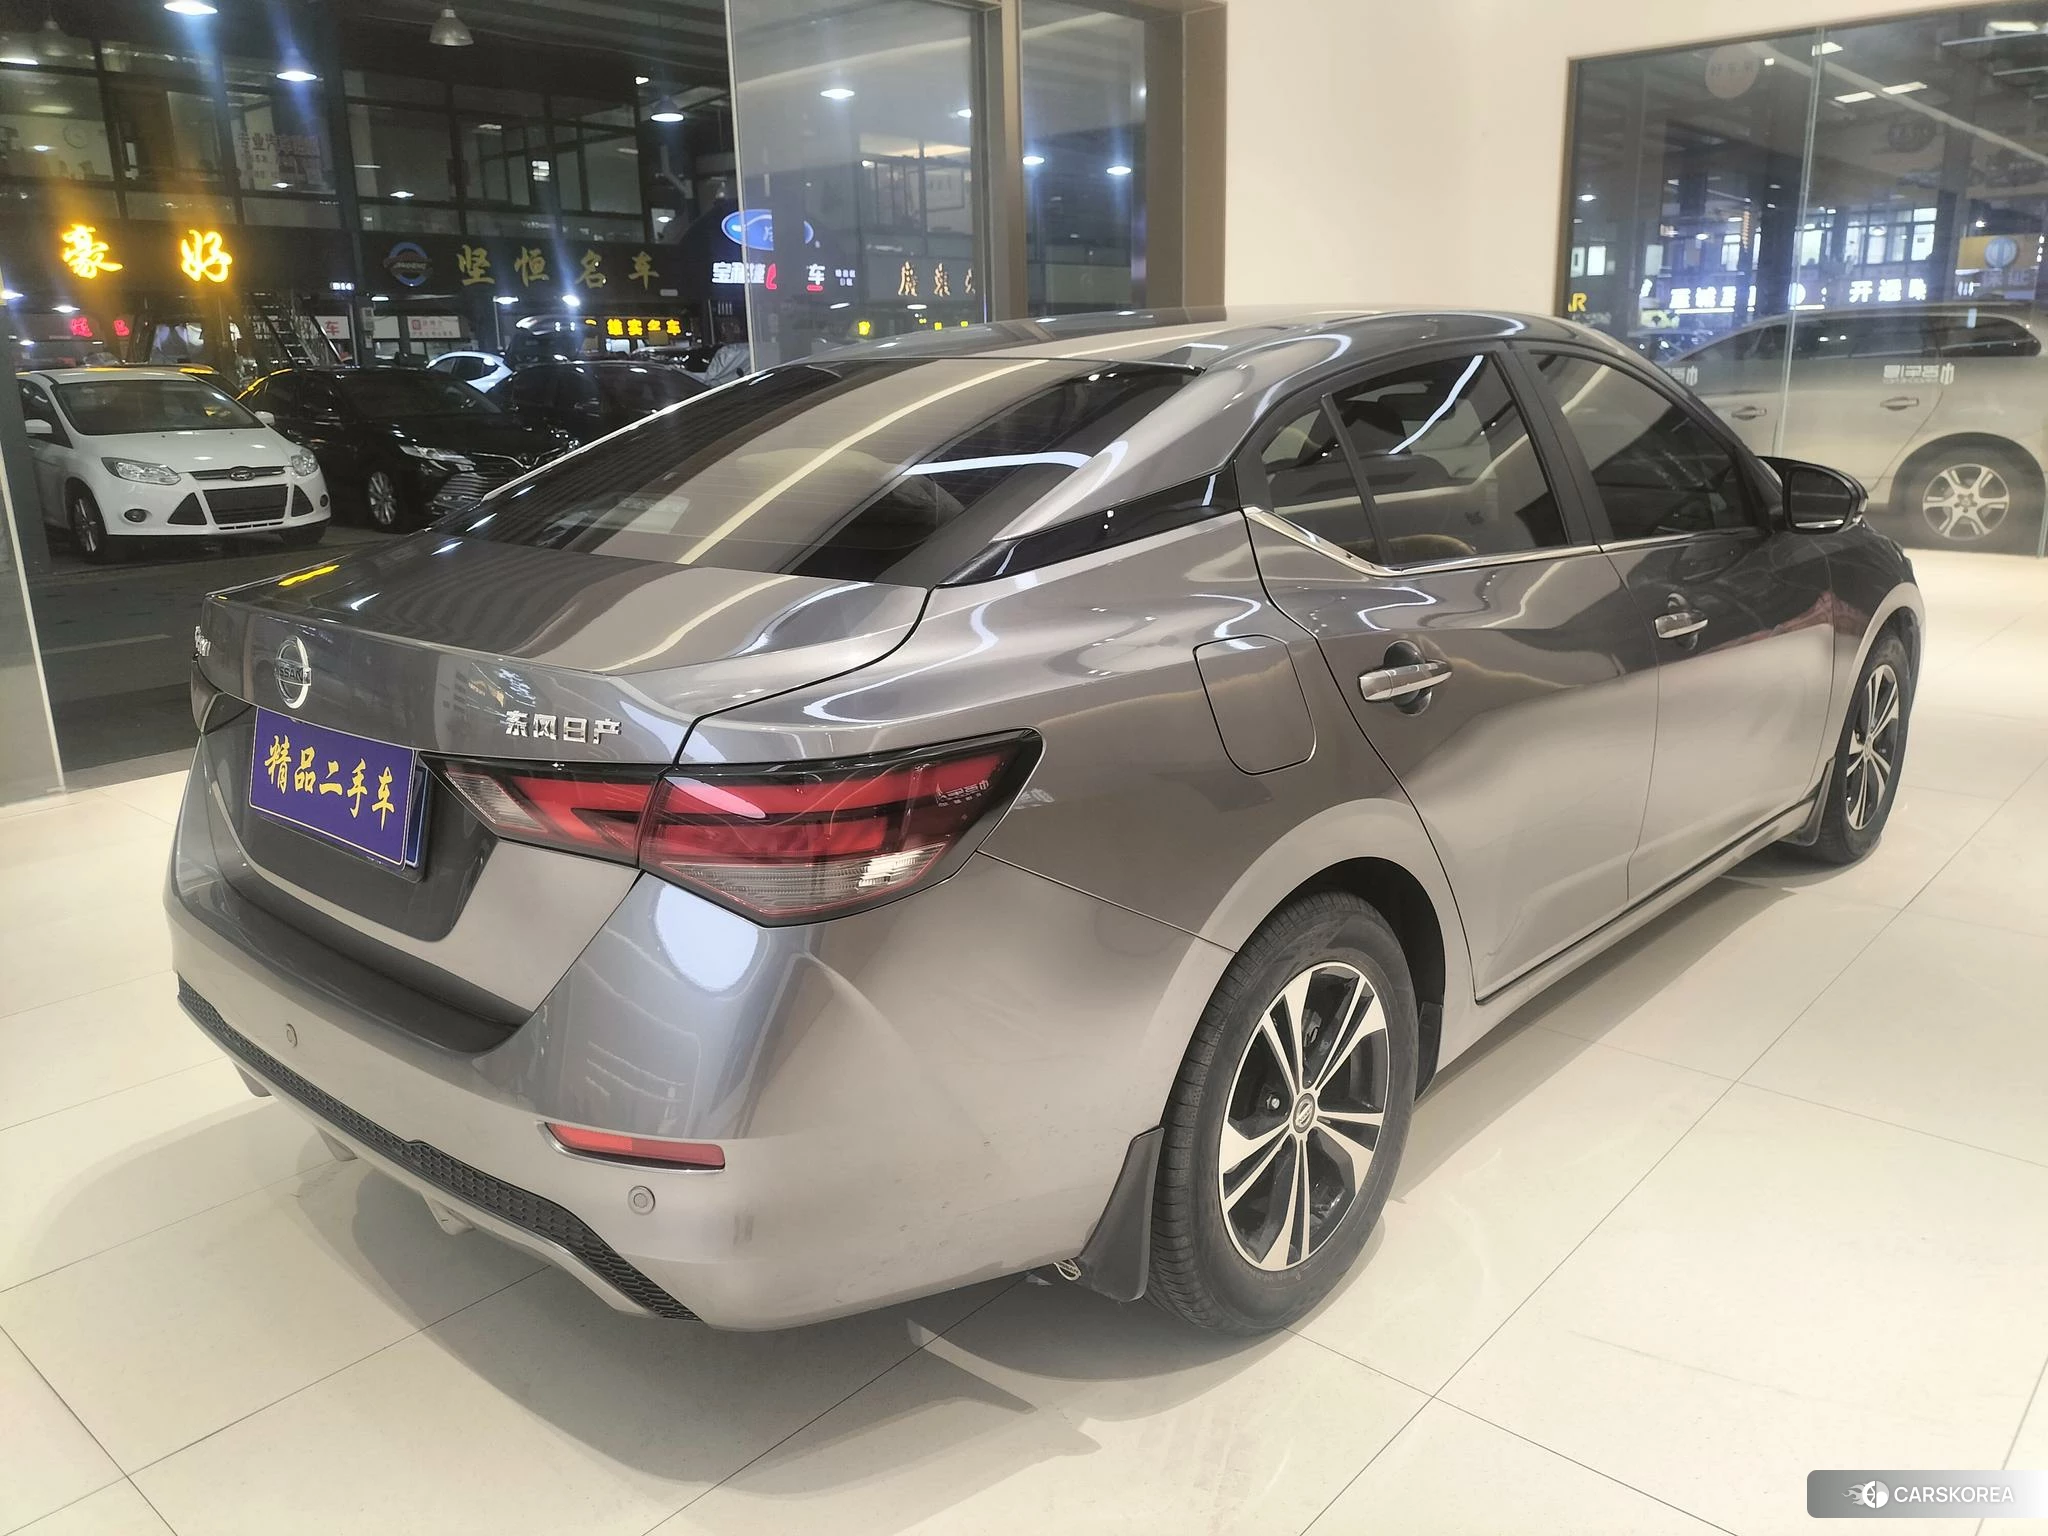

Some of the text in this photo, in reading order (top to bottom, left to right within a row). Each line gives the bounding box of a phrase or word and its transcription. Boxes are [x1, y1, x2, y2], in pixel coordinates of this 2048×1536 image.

[457, 245, 660, 290] 坚恒名车
[505, 709, 623, 745] 东风日产
[264, 734, 396, 831] 精品二手车
